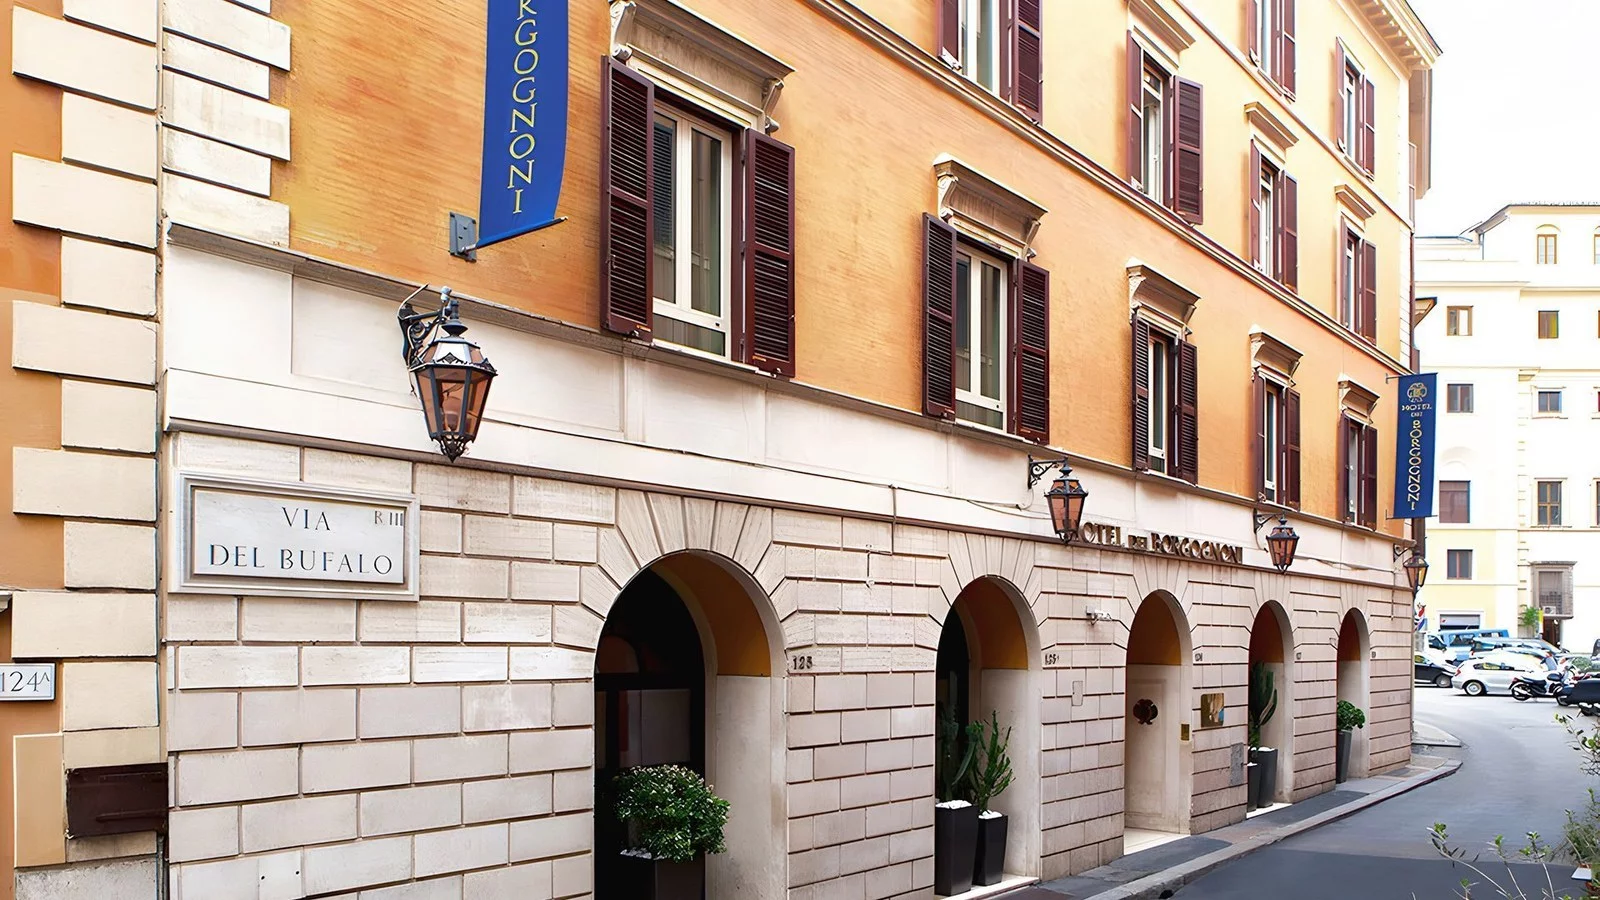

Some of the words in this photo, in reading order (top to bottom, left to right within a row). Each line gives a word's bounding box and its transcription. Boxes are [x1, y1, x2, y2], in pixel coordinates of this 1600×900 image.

[282, 506, 331, 531] VIA
[374, 510, 383, 525] R
[1070, 521, 1122, 546] OTEL
[209, 544, 265, 568] DEL
[280, 548, 392, 575] BUFALO
